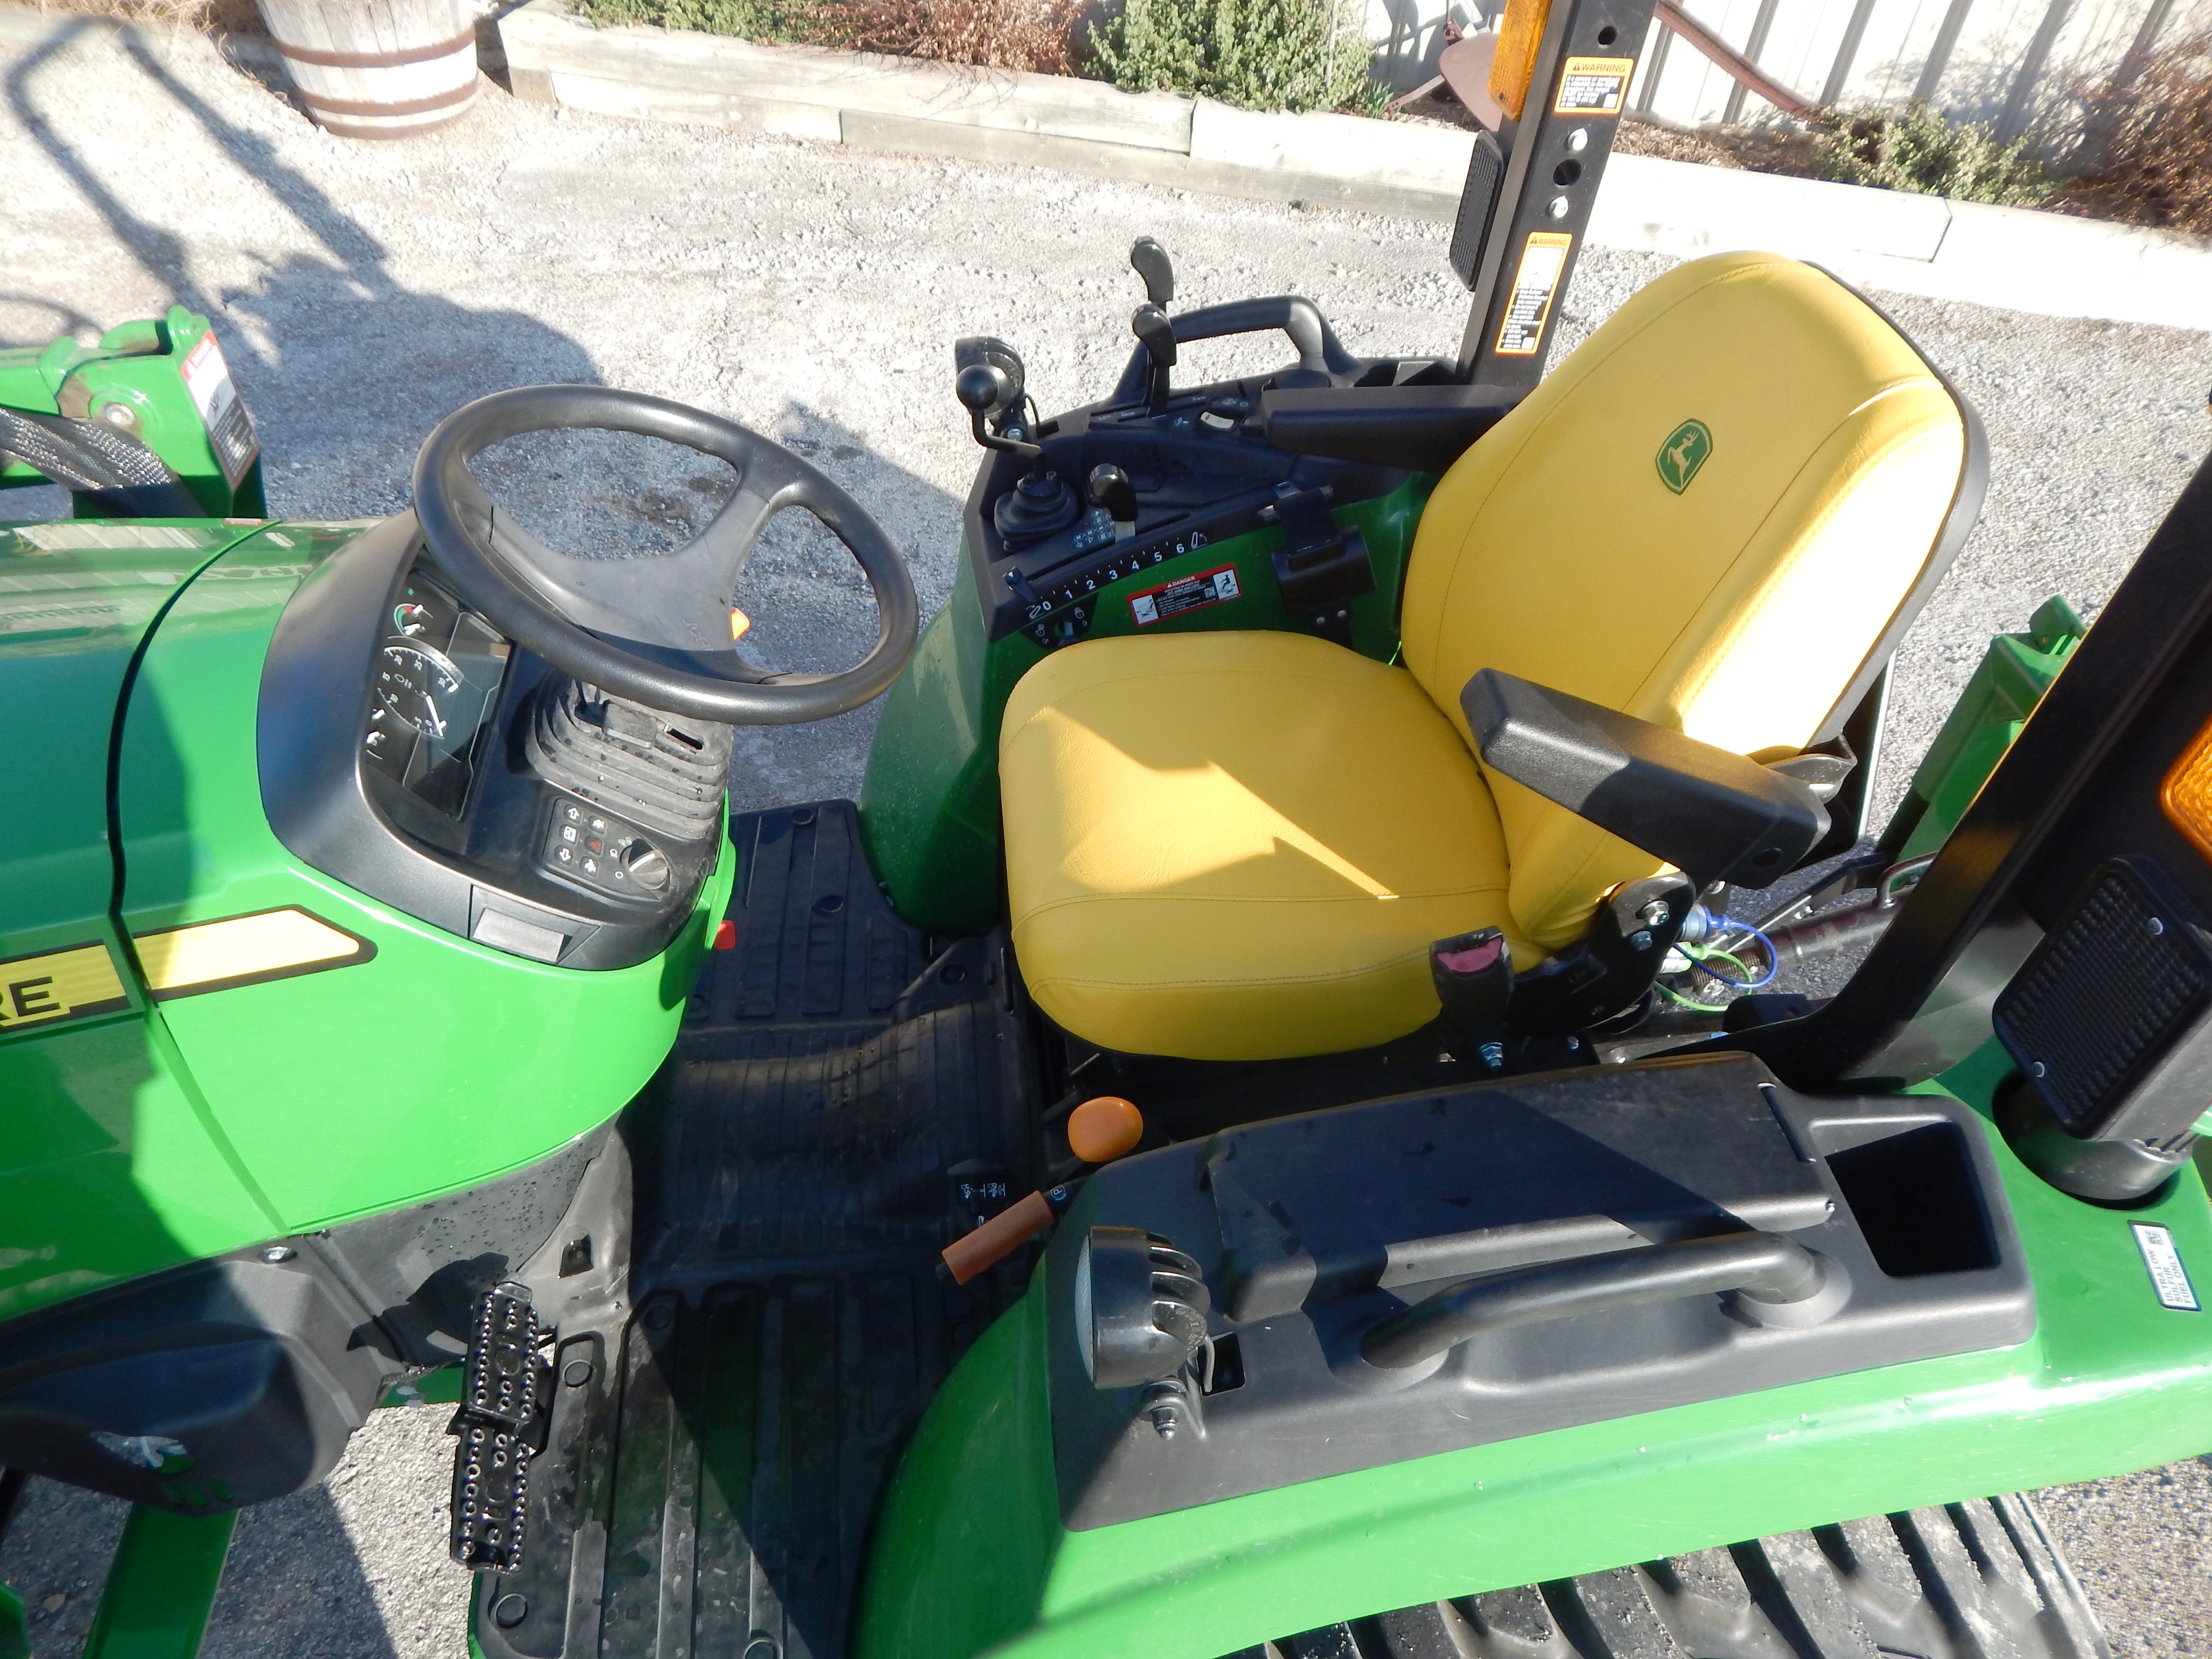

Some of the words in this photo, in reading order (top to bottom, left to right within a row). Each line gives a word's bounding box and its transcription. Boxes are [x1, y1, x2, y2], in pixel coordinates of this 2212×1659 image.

[1582, 63, 1626, 72] WARNING
[1538, 238, 1567, 246] WARNING
[1042, 601, 1051, 611] 0
[1065, 589, 1073, 599] 1
[1086, 580, 1095, 590] 2
[1109, 570, 1118, 580] 3
[1132, 560, 1140, 570] 4
[1154, 551, 1163, 562] 5
[1176, 543, 1184, 553] 6
[1172, 576, 1196, 587] DANGER
[0, 975, 60, 1021] E
[2147, 1249, 2161, 1269] LOW
[2167, 1254, 2181, 1278] ONLY
[2156, 1272, 2173, 1301] ULTRA
[2163, 1267, 2183, 1302] SULFUR
[2178, 1283, 2192, 1303] FUEL
